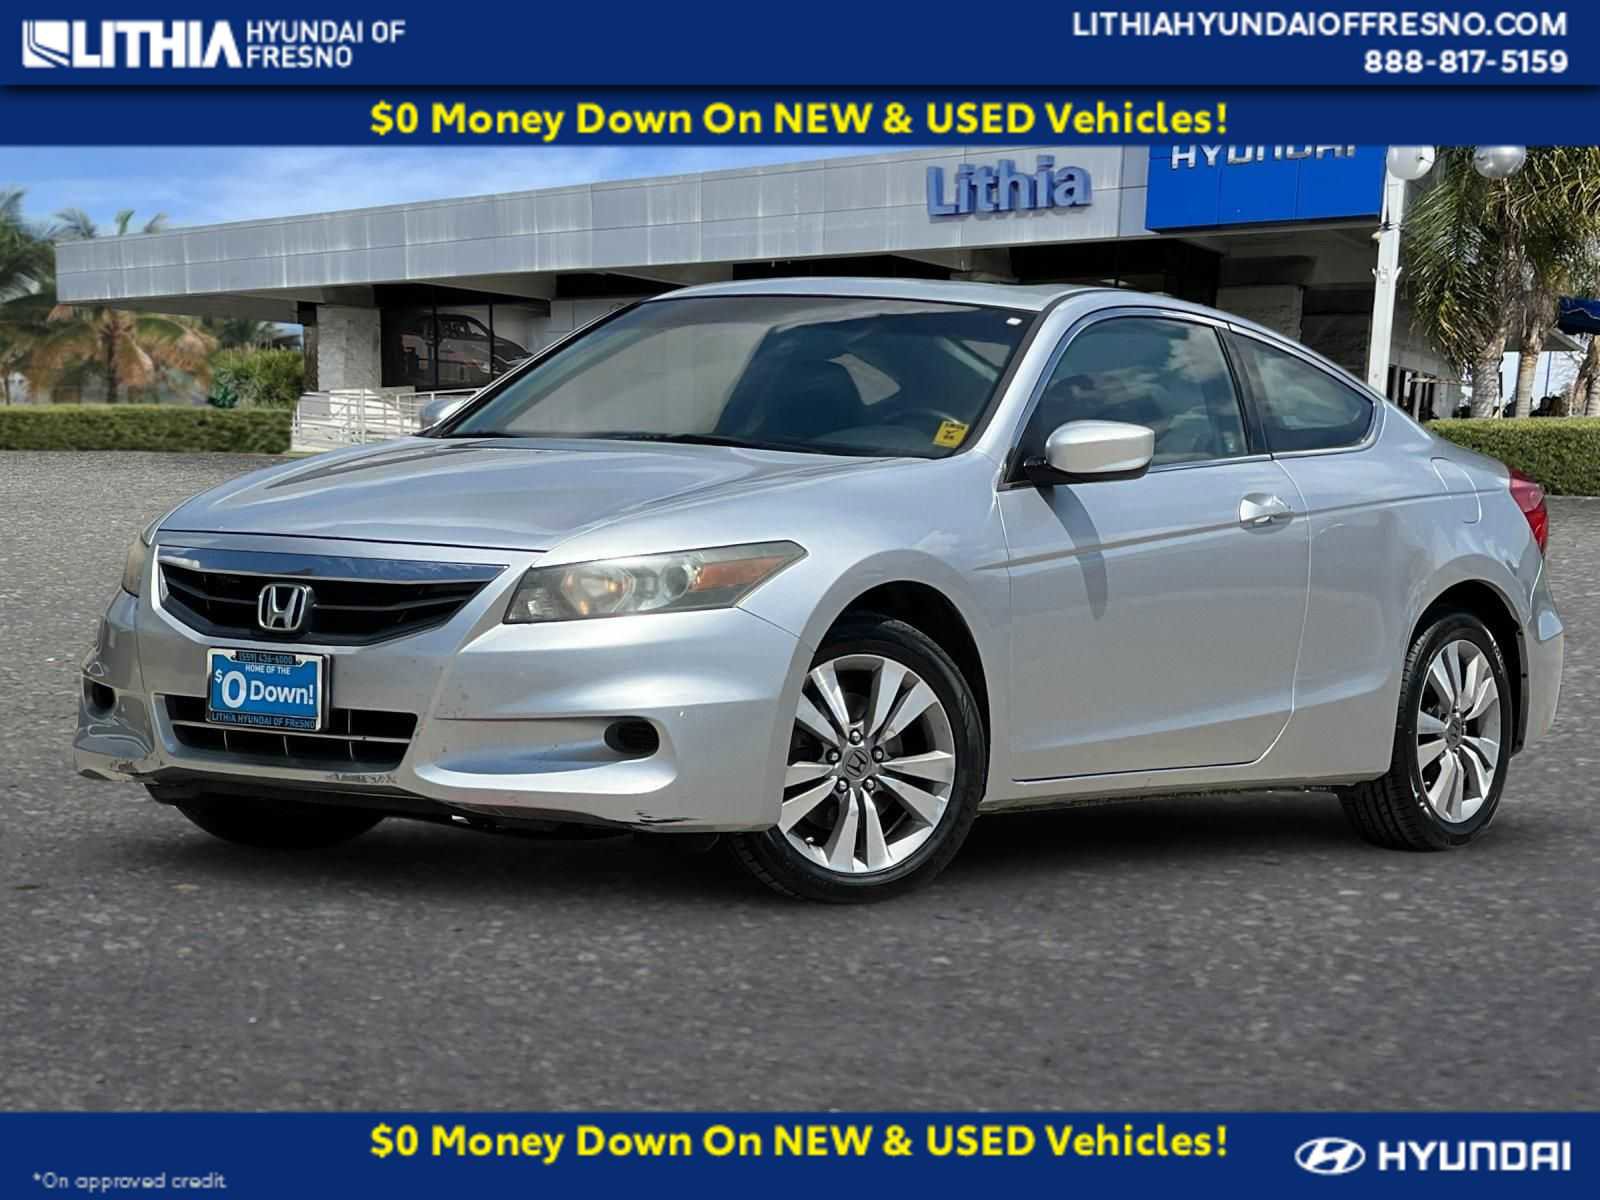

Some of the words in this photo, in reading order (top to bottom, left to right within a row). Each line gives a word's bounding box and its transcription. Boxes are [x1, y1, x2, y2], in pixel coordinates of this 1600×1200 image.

[926, 154, 1092, 216] Lithia
[214, 668, 247, 708] $0
[249, 680, 314, 705] Down!
[245, 664, 265, 673] HOME
[266, 665, 276, 674] OF
[277, 666, 291, 676] THE
